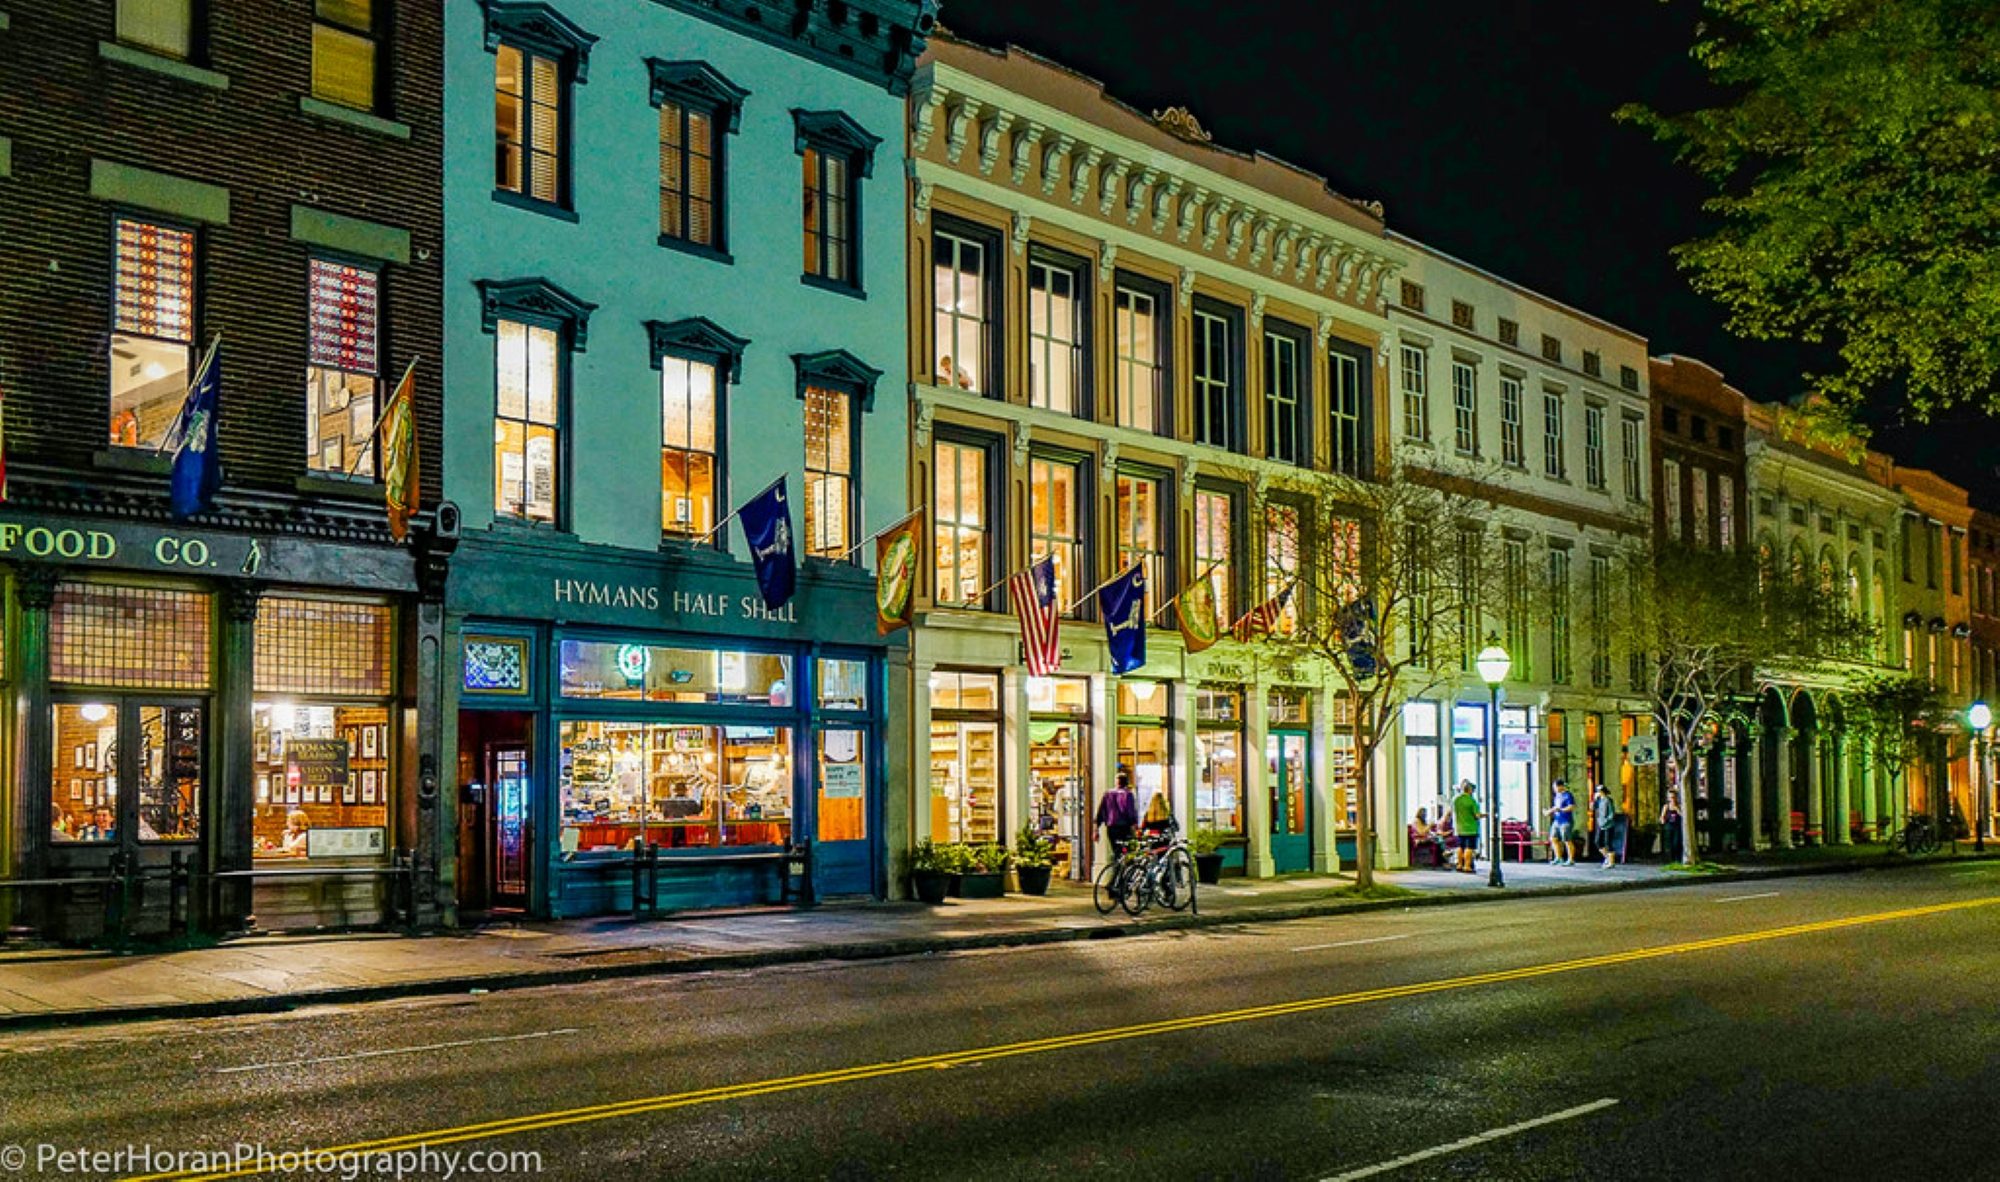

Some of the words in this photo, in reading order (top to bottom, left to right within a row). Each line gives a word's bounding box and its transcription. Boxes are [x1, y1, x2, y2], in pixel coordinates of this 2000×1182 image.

[0, 522, 116, 560] FOOD
[154, 536, 218, 567] CO.
[554, 578, 659, 610] HYMANS
[673, 590, 729, 616] HALF
